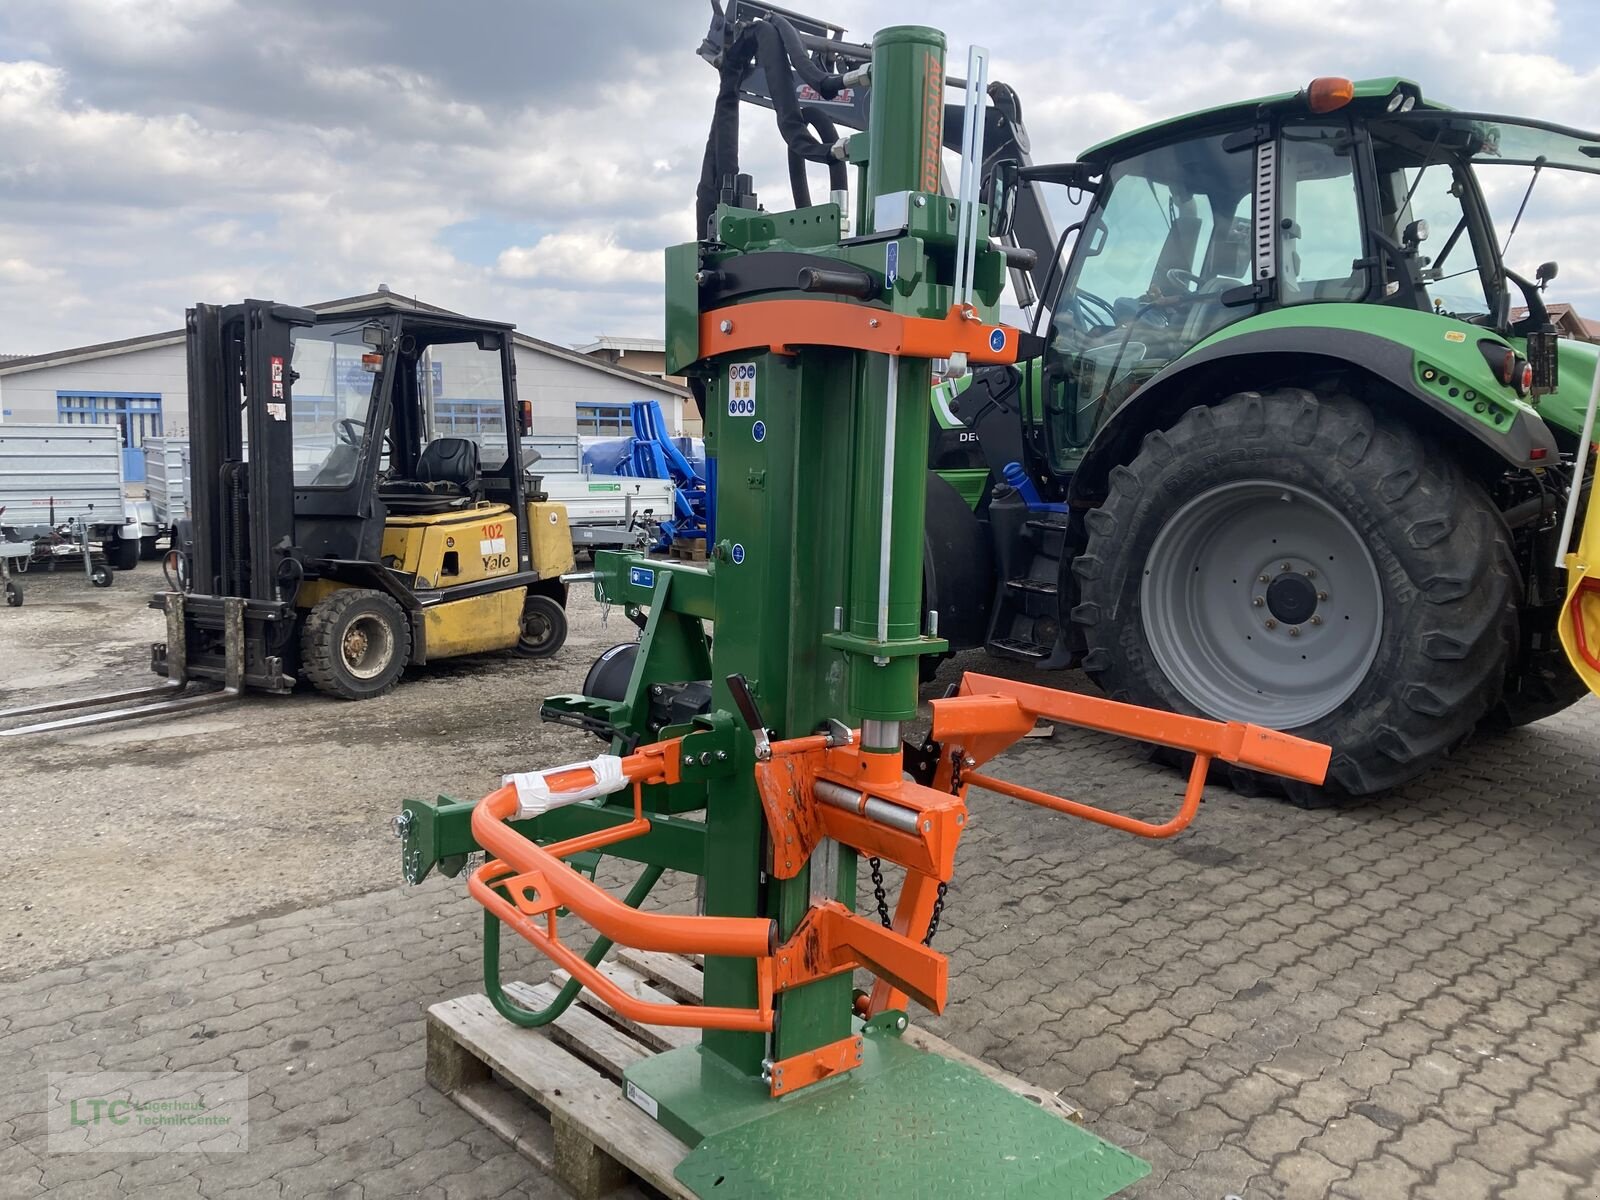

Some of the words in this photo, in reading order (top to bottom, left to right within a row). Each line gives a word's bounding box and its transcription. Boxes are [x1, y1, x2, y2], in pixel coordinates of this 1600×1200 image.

[926, 56, 943, 192] AUTOSPEED
[482, 524, 503, 539] 102
[482, 554, 511, 571] Yale
